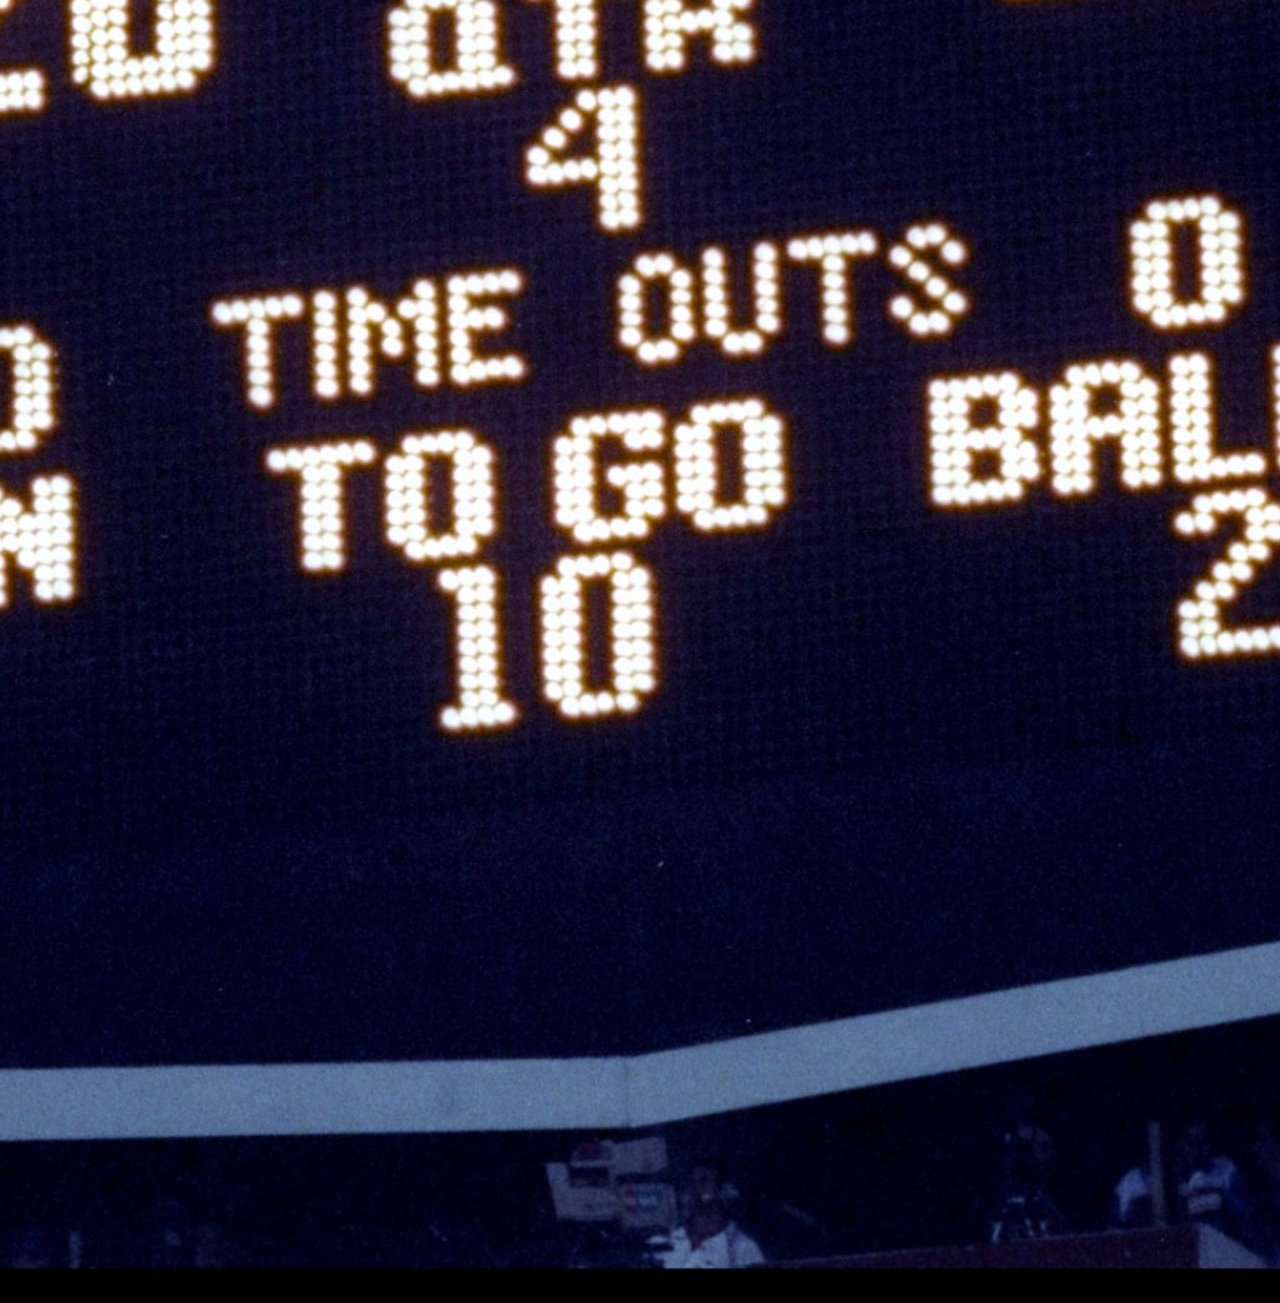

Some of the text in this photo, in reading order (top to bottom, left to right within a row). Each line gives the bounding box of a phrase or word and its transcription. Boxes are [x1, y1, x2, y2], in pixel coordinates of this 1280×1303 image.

[525, 84, 641, 231] 4
[211, 269, 525, 408] TIME
[617, 223, 967, 365] OUTS
[1129, 195, 1244, 329] 0
[266, 397, 787, 571] TO GO
[437, 550, 656, 731] 10
